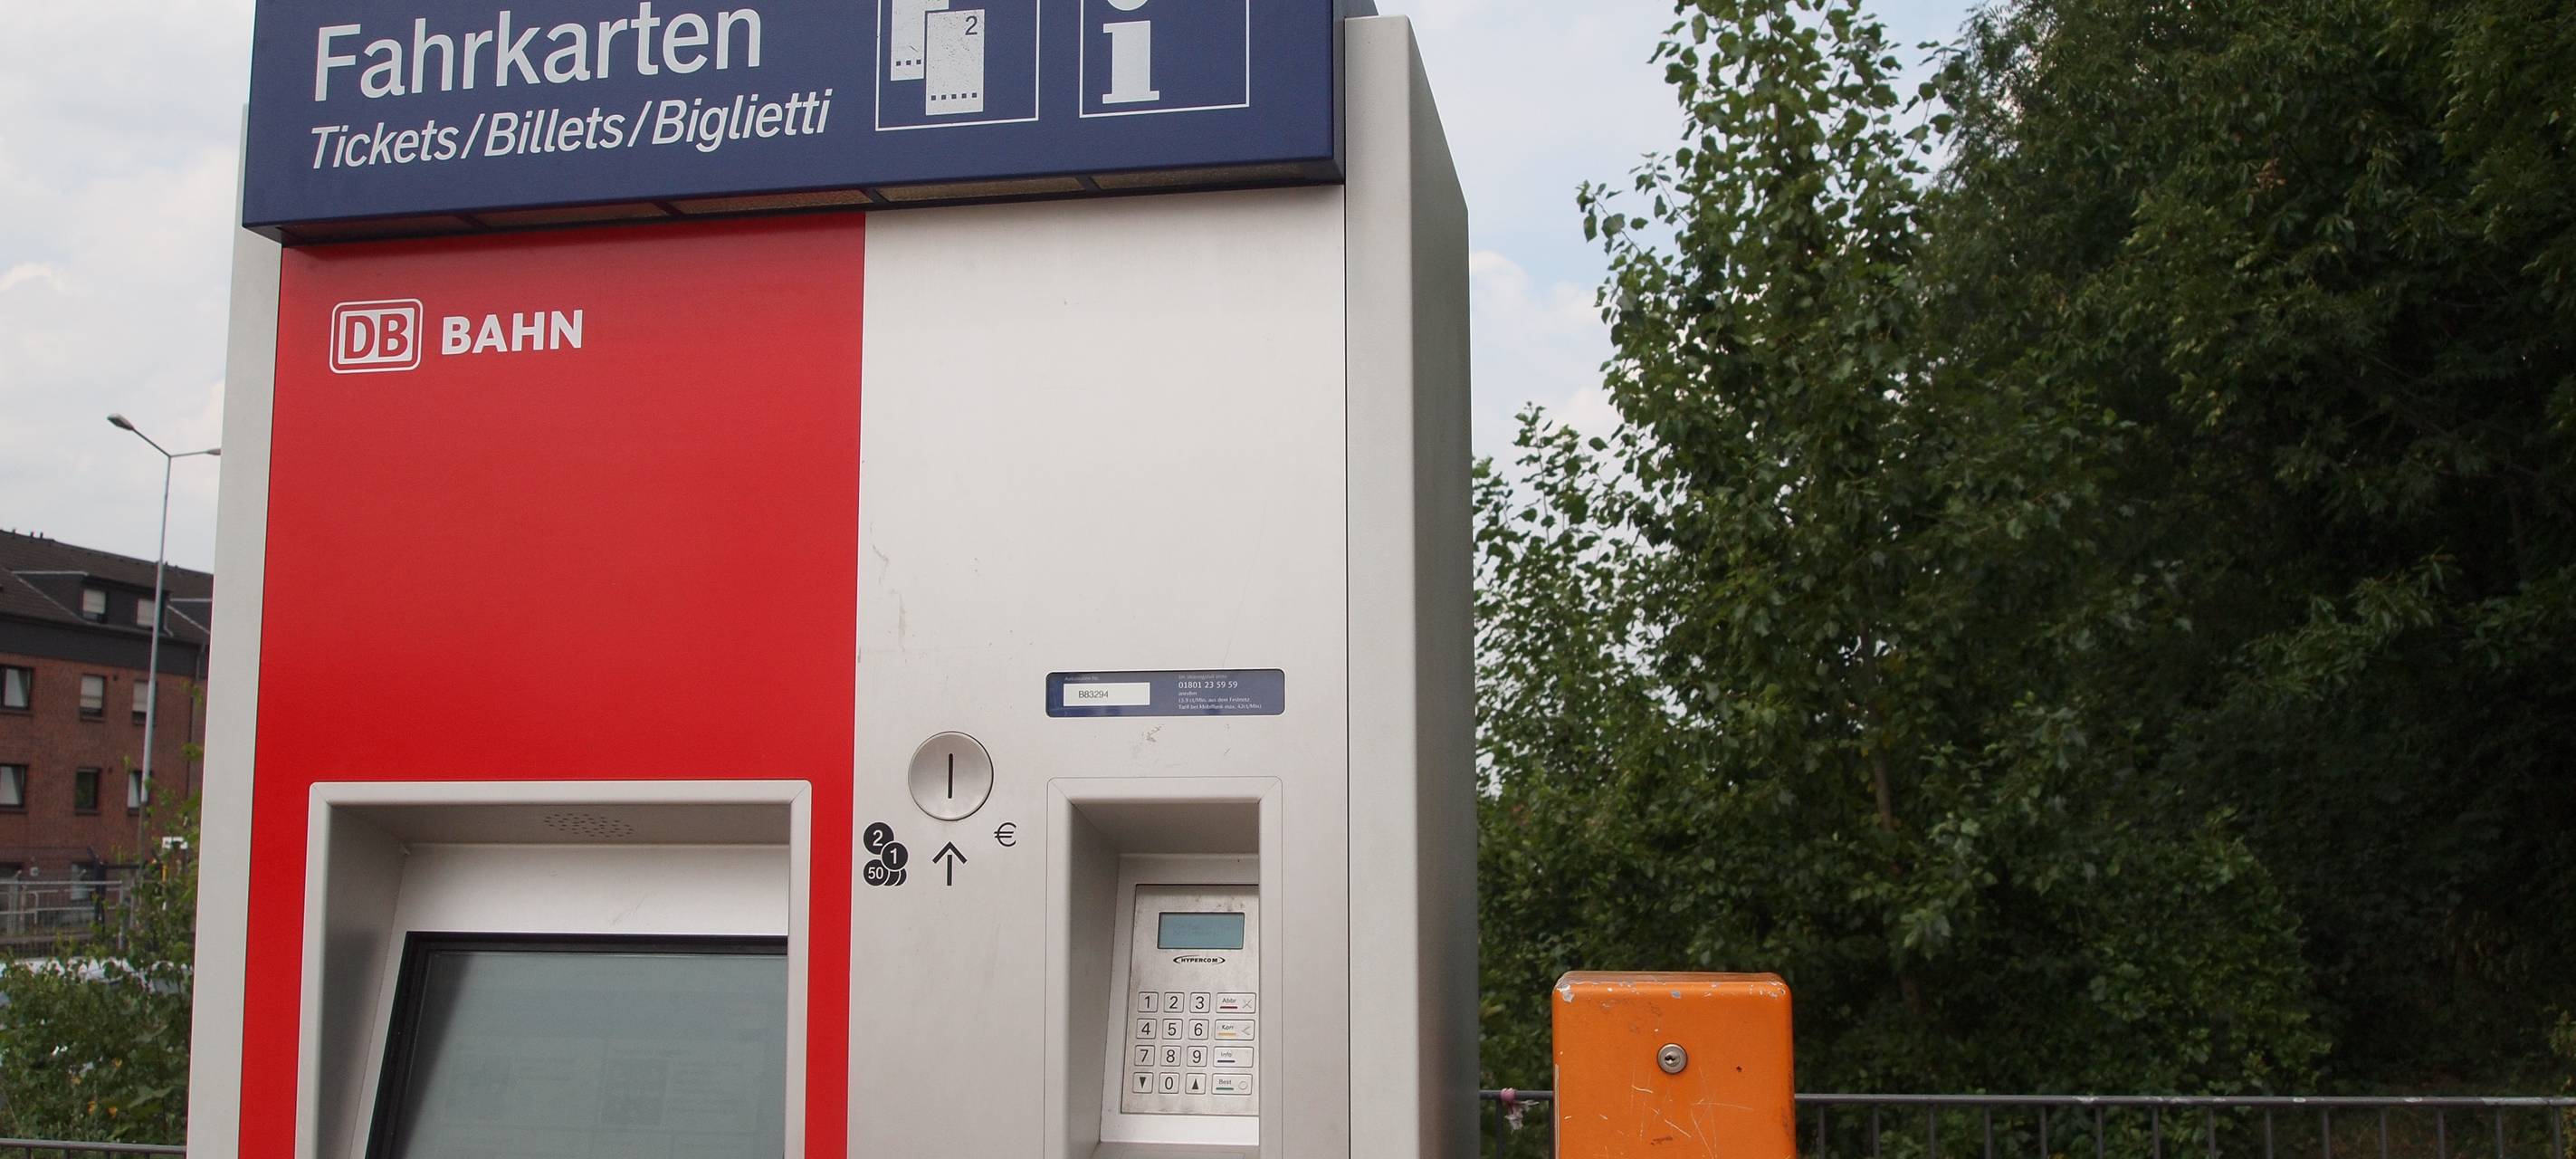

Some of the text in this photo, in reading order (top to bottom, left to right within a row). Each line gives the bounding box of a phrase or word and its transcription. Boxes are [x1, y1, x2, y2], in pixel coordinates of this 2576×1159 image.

[964, 15, 978, 35] 2
[313, 2, 762, 102] Fahrkarten
[310, 89, 834, 170] Tickets/Billets/Biglietti
[344, 310, 584, 359] DB BAHN
[1178, 681, 1238, 689] 01801 23 59 59
[1078, 690, 1109, 699] B83294
[872, 829, 883, 847] 2
[890, 848, 897, 865] 1
[868, 867, 884, 880] 50
[1144, 996, 1150, 1009] 1
[1169, 996, 1178, 1010] 2
[1195, 996, 1205, 1010] 3
[1141, 1022, 1150, 1035] 4
[1168, 1023, 1177, 1036] 5
[1194, 1022, 1203, 1036] 6
[1140, 1049, 1149, 1062] 7
[1166, 1049, 1176, 1063] 8
[1192, 1049, 1202, 1063] 9
[1165, 1077, 1174, 1089] 0
